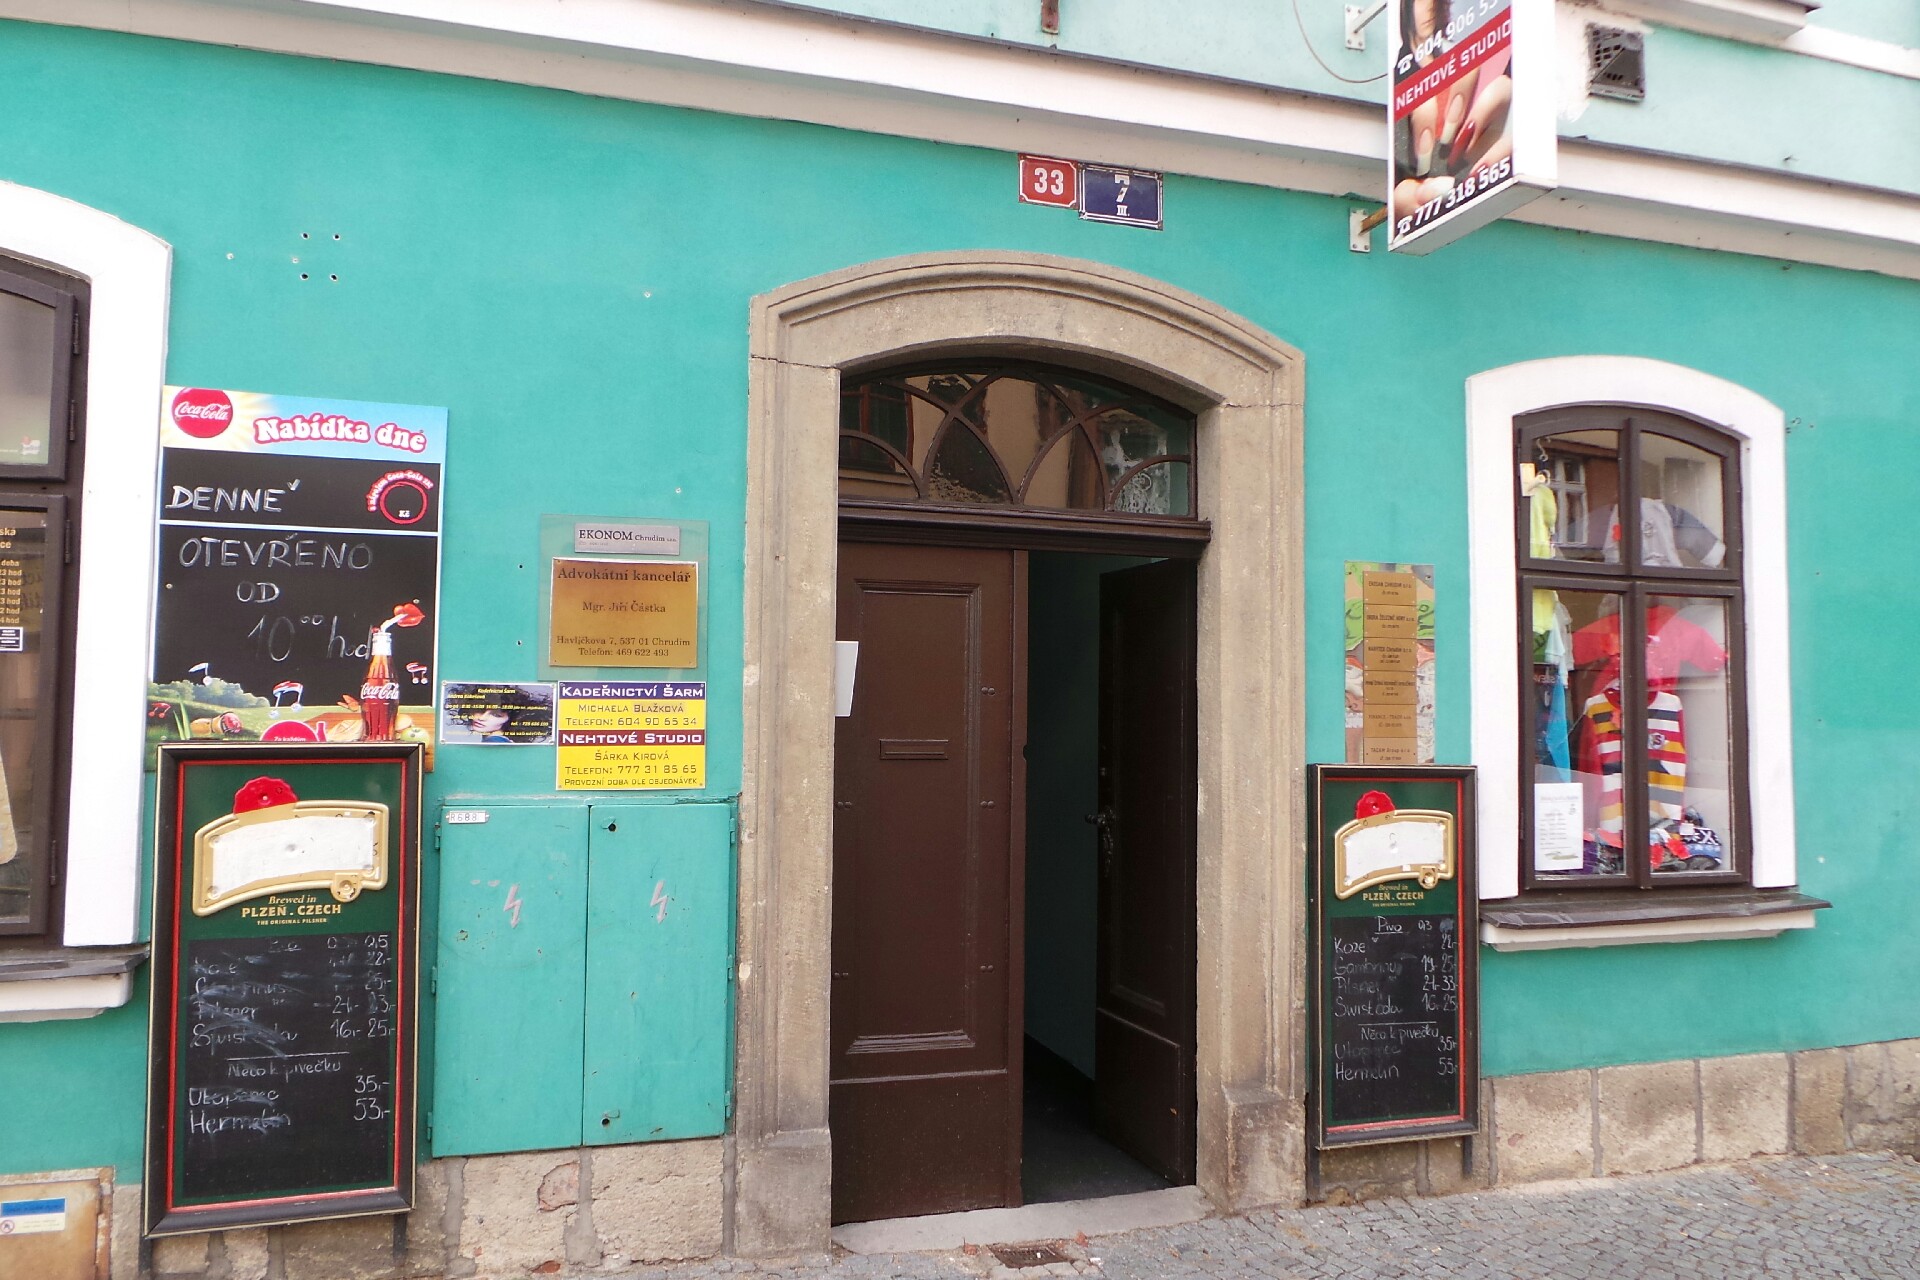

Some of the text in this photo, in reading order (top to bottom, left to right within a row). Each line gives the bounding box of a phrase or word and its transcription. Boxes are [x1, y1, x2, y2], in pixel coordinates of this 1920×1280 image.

[1415, 30, 1442, 62] 604
[1445, 6, 1475, 40] 906
[1395, 20, 1512, 111] NEHTOVÉ STUDIO
[1034, 167, 1064, 195] 33
[1114, 174, 1130, 203] 7
[1415, 156, 1511, 226] 777 318 565
[174, 401, 230, 421] Coca-Cola
[256, 415, 369, 442] Nabídka
[579, 530, 633, 540] EKONOM
[634, 534, 665, 542] Chrudim
[557, 567, 691, 583] Advokátní kancelář
[236, 582, 280, 603] OD
[582, 600, 666, 613] Mgr. Jiří Částka
[556, 635, 606, 646] Havlíčkova
[620, 637, 636, 645] 537
[638, 637, 649, 645] 01
[652, 637, 690, 646] Chrudim
[578, 647, 669, 657] Telefon: 469 622 493
[361, 682, 399, 700] Coca-Cola
[562, 684, 703, 697] KADEŘNICTVÍ ŠARM
[578, 703, 684, 713] MICHAELA BLAŽKOVÁ
[565, 717, 613, 726] TELEFON:
[617, 717, 640, 726] 604
[645, 717, 660, 726] 90
[683, 717, 697, 726] 34
[562, 731, 702, 744] NEHTOVÉ STUDIO
[594, 750, 669, 761] ŠÁRKA KIROVÁ
[564, 764, 697, 775] TELEFON: 777 31 85 65
[268, 895, 317, 904] Brewed in
[1396, 892, 1424, 900] CZECH
[241, 904, 341, 918] PLZEŇ CZECH
